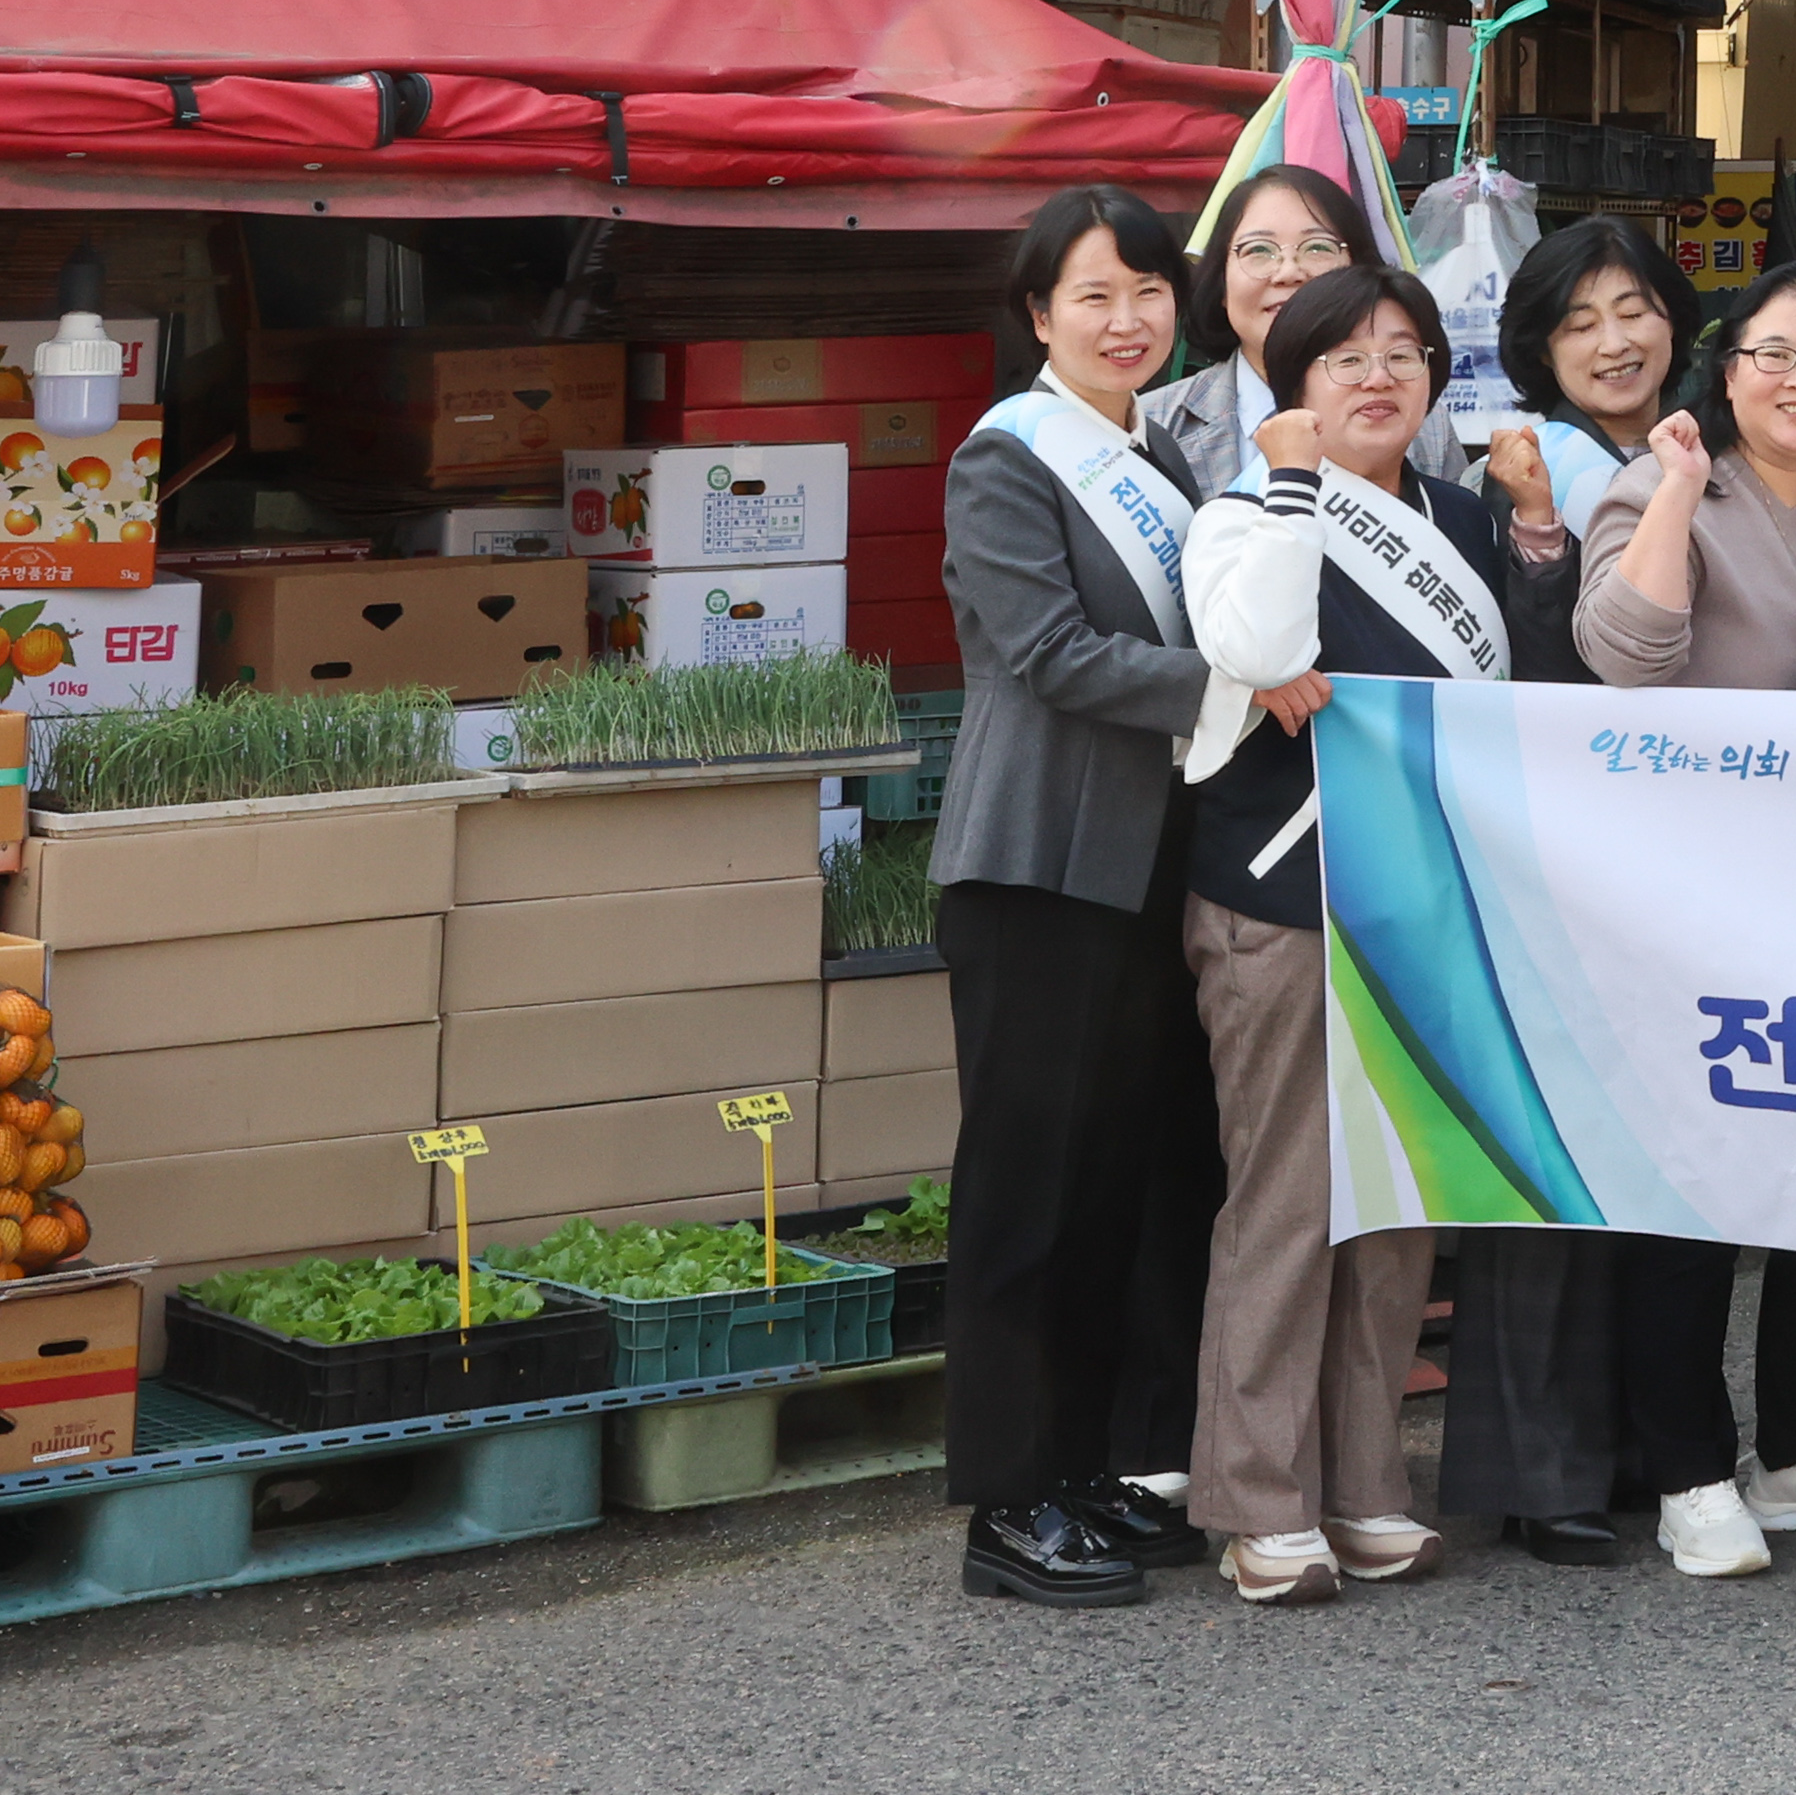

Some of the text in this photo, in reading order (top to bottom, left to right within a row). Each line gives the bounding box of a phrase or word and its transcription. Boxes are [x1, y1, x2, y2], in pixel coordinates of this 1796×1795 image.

[120, 569, 141, 582] 5kg
[1322, 491, 1497, 674] 도민과 함께하는
[105, 623, 179, 664] 단감
[48, 681, 89, 697] 10kg
[1719, 739, 1791, 782] 의회
